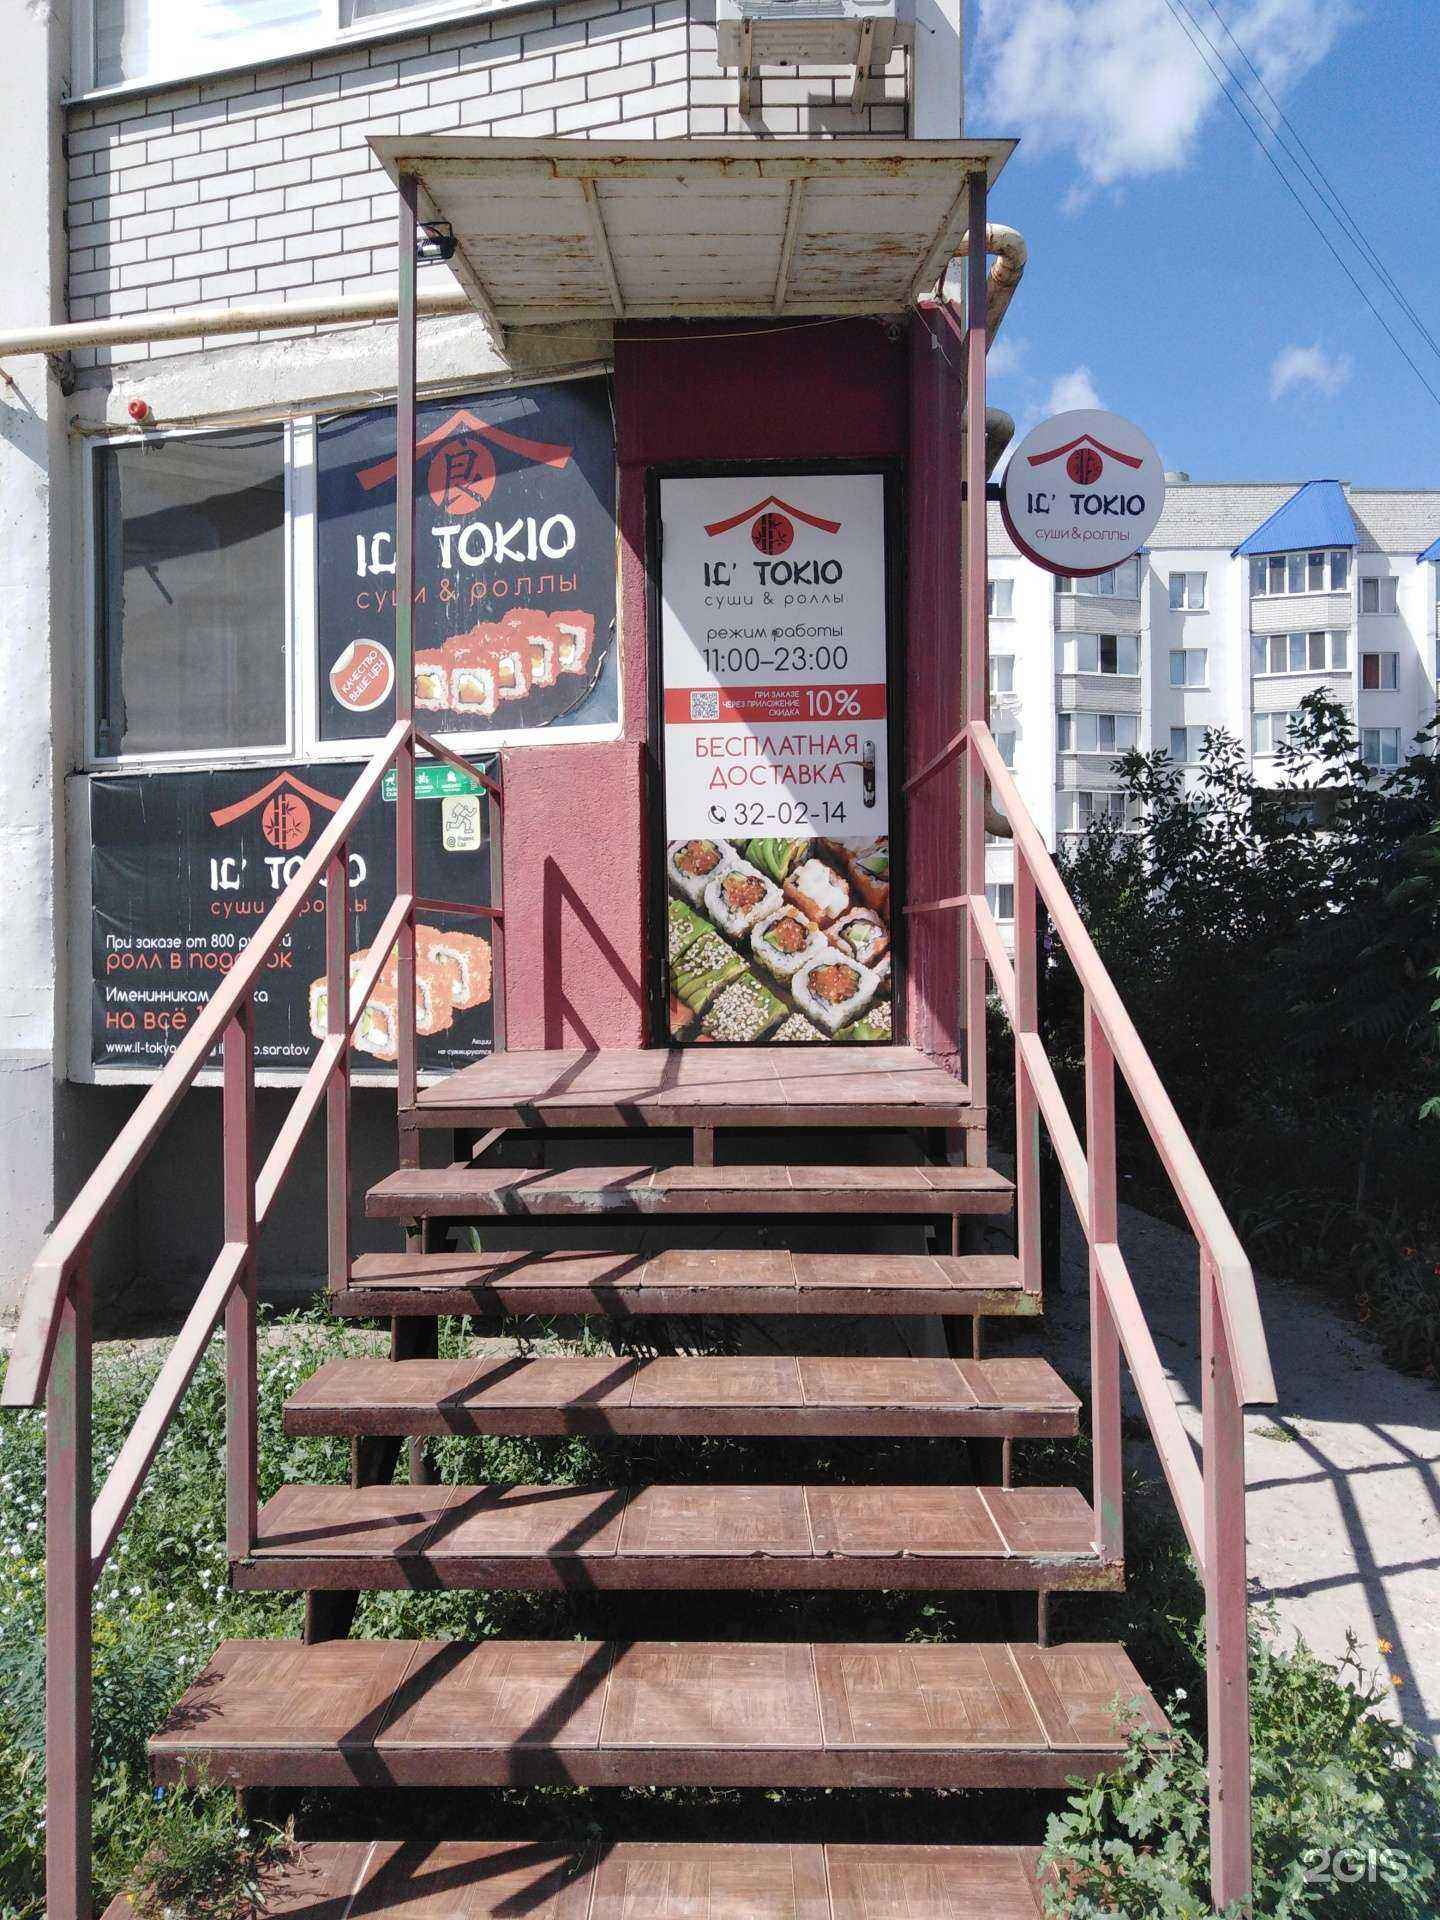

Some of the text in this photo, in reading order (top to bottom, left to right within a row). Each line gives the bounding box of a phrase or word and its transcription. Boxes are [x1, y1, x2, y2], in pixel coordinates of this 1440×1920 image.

[1070, 494, 1145, 516] TOKIO
[432, 514, 576, 568] TOKIO
[753, 560, 843, 586] TOKIO
[356, 573, 577, 613] суи & роллы
[704, 592, 844, 609] суши & роллы
[707, 623, 843, 643] режим работы
[702, 646, 848, 672] 11:00-23:00
[341, 650, 378, 693] КАЧЕСТВО
[722, 699, 801, 709] ЧЕРЕЗ ПРИЛОЖЕНИЕ
[772, 690, 800, 698] ЗАКАЗЕ
[806, 689, 861, 717] 10%
[768, 708, 801, 717] СКИДКА
[696, 734, 858, 758] БЕСПЛАТНАЯ
[709, 764, 846, 790] ДОСТАВКА
[734, 802, 847, 825] 32-02-14
[264, 853, 367, 889] TOO
[211, 901, 264, 919] суши
[106, 935, 132, 953] При
[136, 938, 181, 949] заказе
[186, 939, 207, 949] от
[211, 934, 235, 949] 800
[106, 952, 162, 974] ролл
[189, 952, 293, 975] подок
[106, 986, 210, 1002] Именинникам
[106, 1012, 135, 1029] на
[144, 1008, 187, 1029] всё
